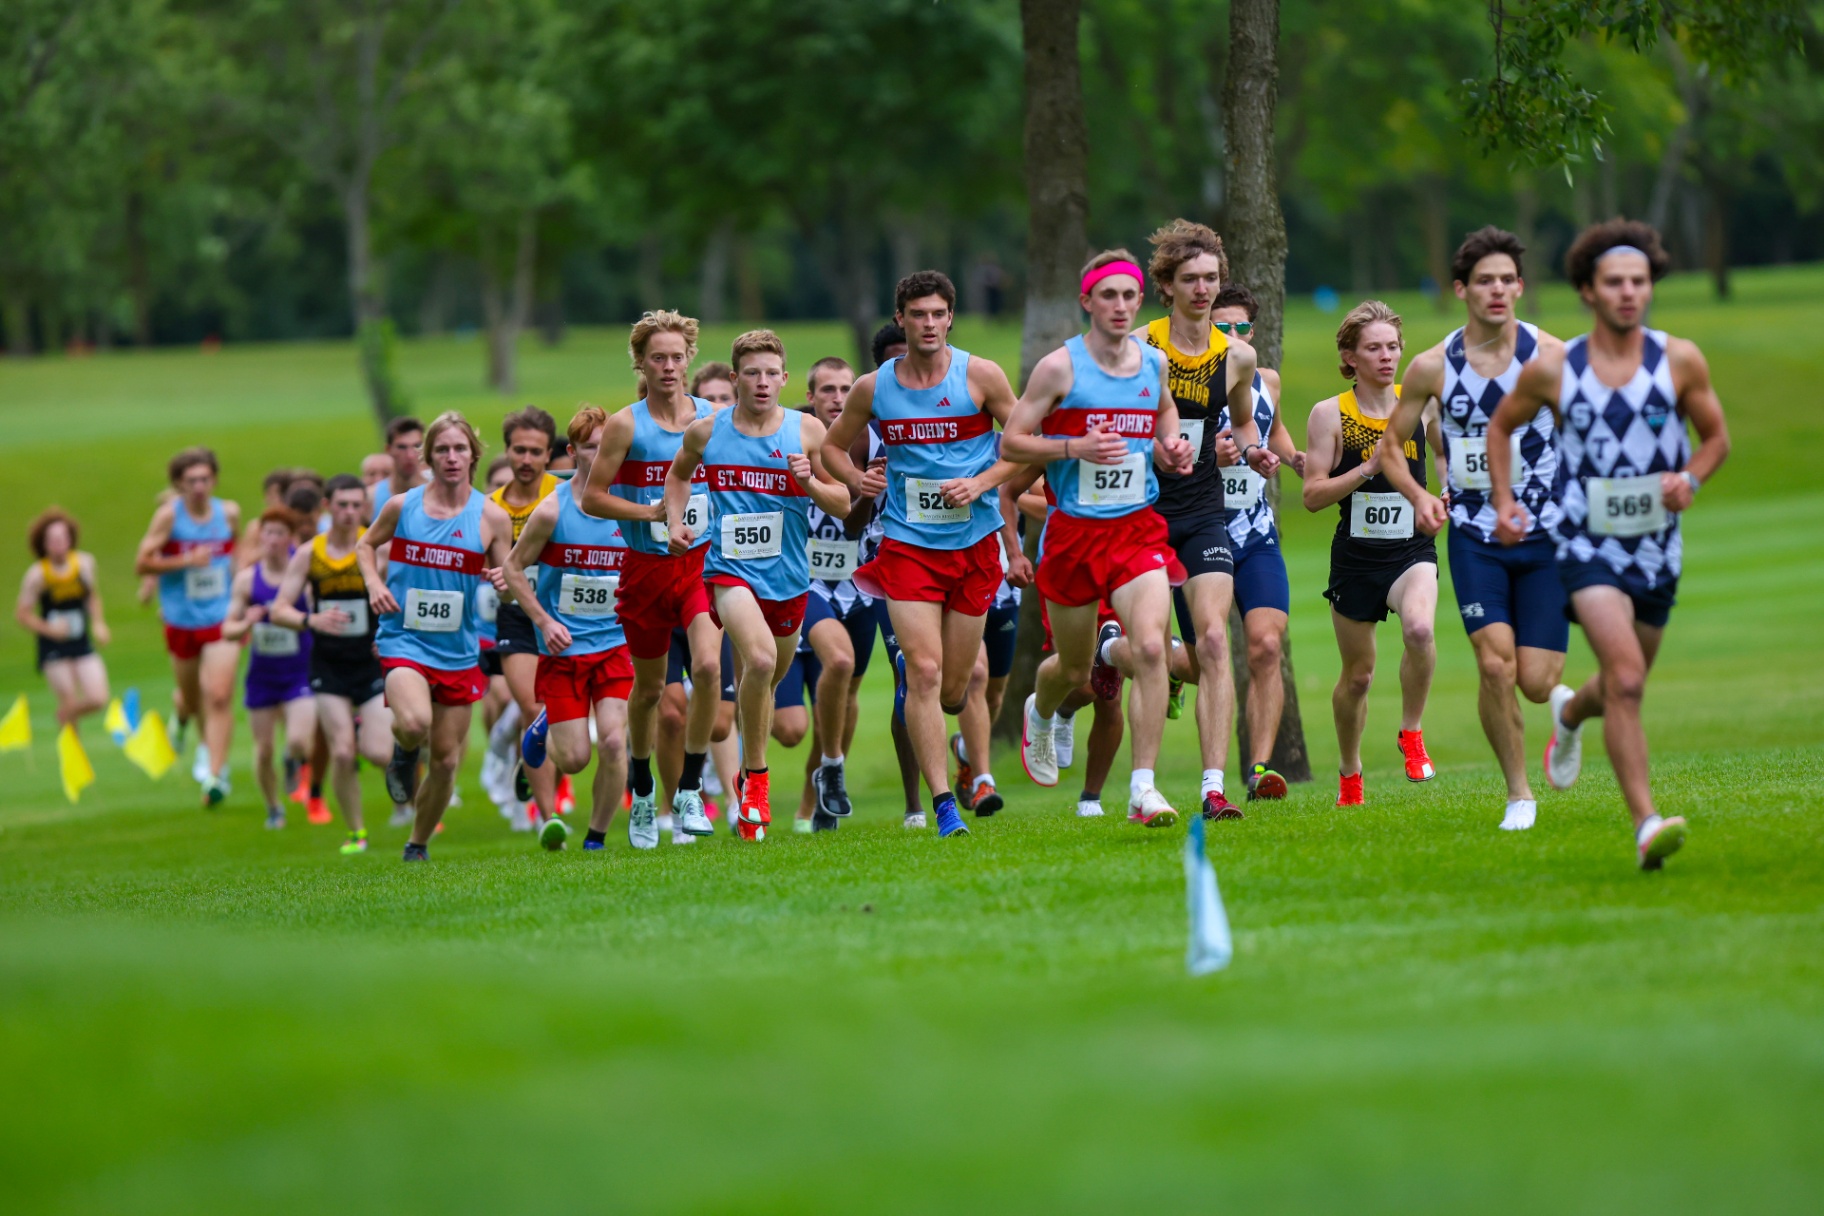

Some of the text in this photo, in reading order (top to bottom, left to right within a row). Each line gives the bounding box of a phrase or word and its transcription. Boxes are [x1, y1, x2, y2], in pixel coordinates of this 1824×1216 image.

[1465, 452, 1489, 473] 58
[1095, 469, 1133, 490] 527
[1606, 492, 1653, 518] 569
[1365, 506, 1402, 525] 607
[734, 525, 771, 545] 550
[811, 551, 846, 569] 573
[572, 587, 608, 605] 538
[416, 601, 451, 619] 548
